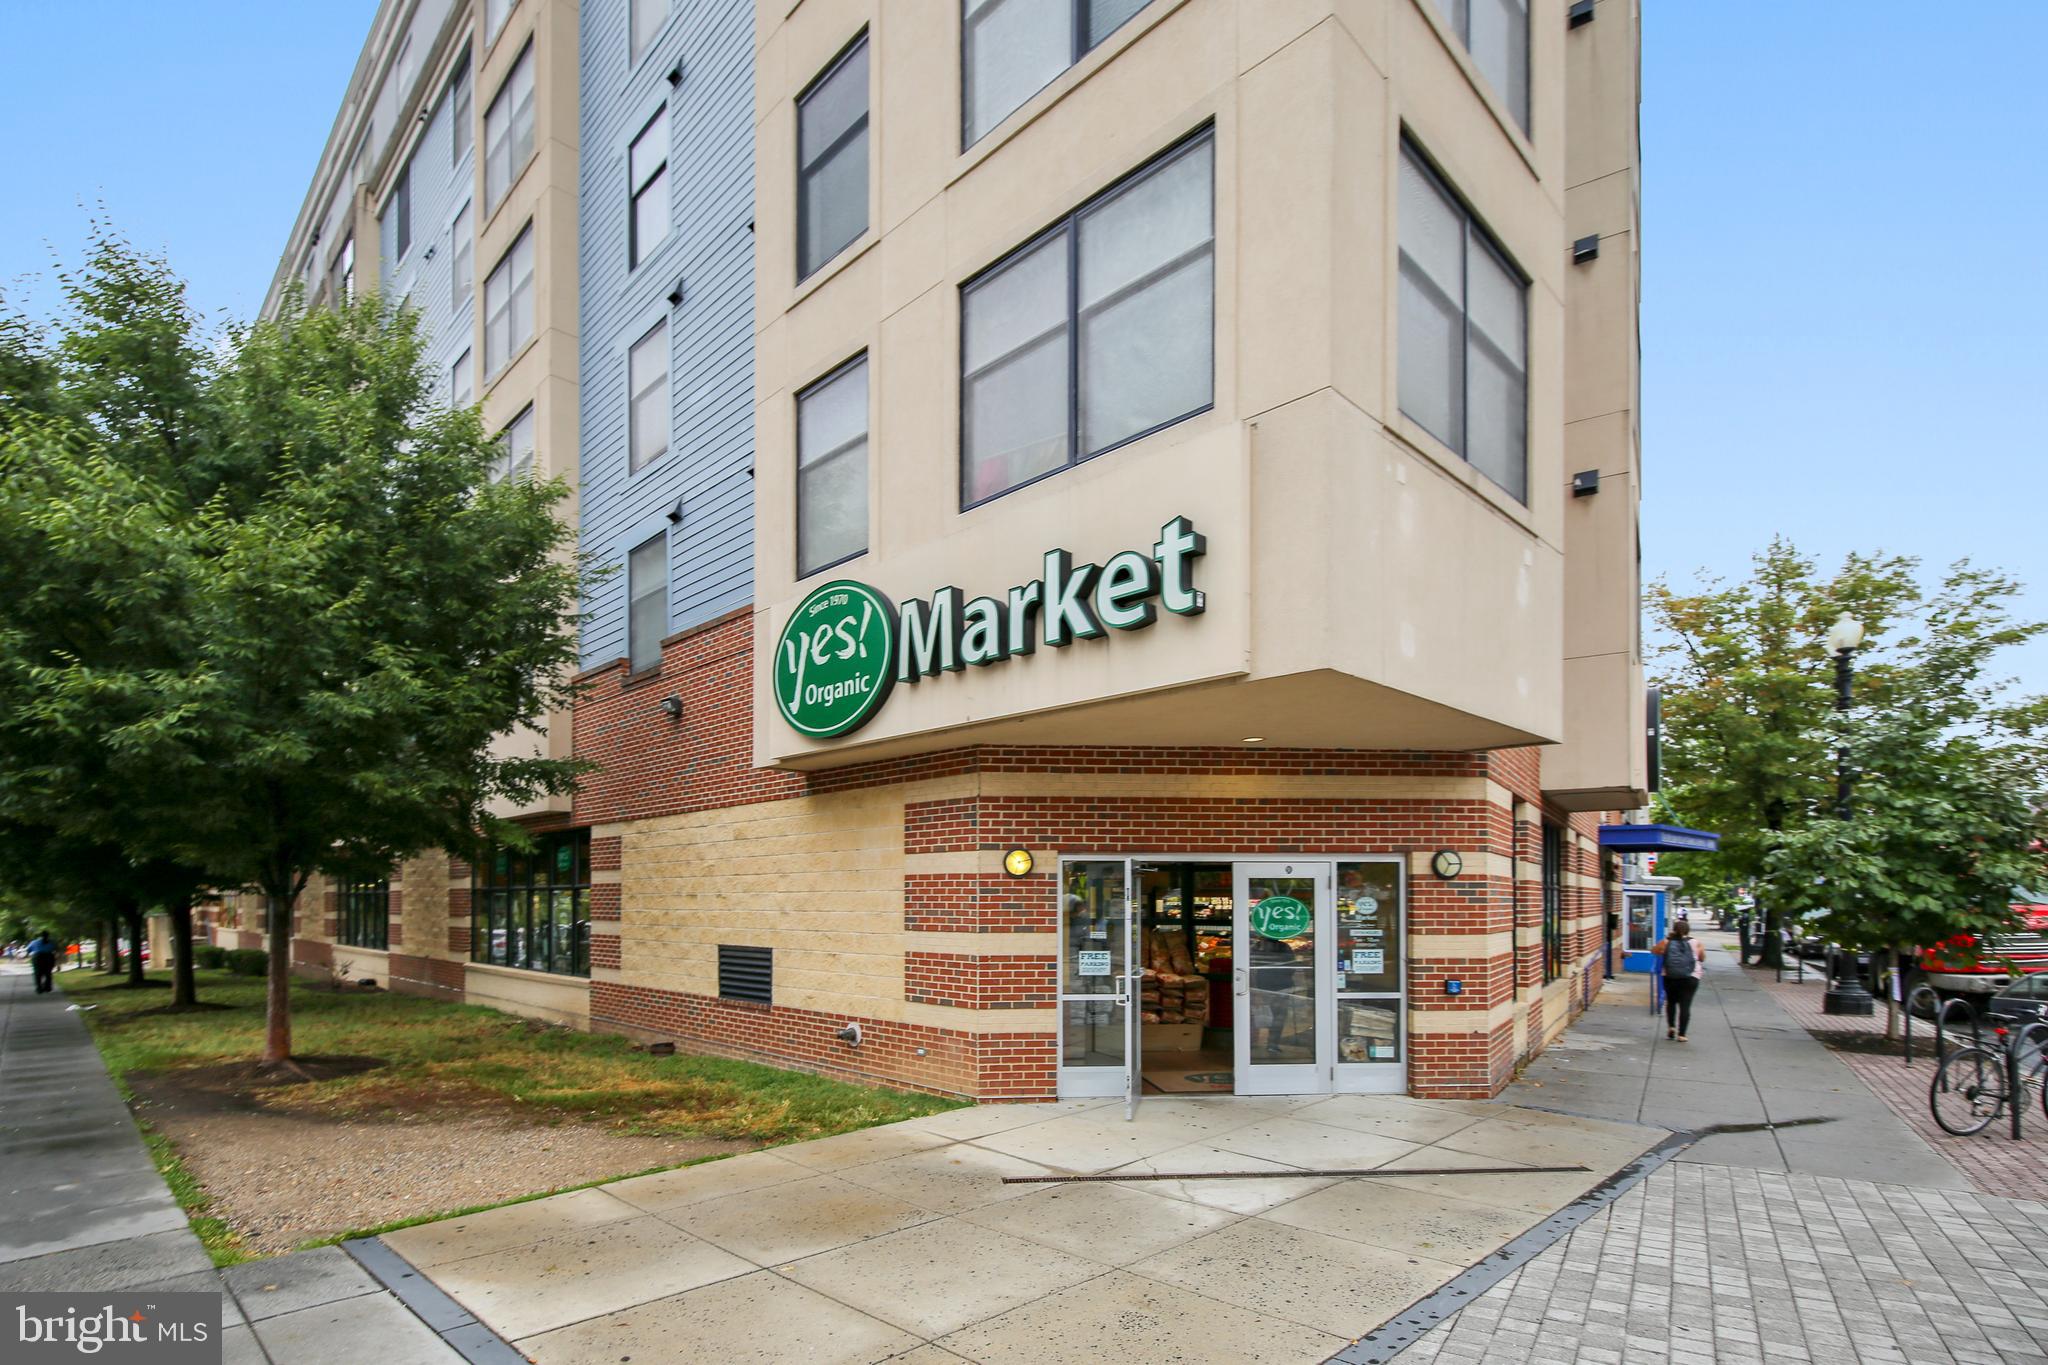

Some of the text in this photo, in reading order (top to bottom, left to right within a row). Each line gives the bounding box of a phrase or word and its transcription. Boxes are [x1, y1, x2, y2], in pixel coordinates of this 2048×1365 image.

[809, 594, 849, 617] Since 1970
[897, 515, 1206, 683] Market
[785, 600, 872, 714] yes!
[805, 672, 870, 707] Organic
[1257, 904, 1302, 932] yes!
[1269, 923, 1302, 932] Organic
[1353, 951, 1381, 959] FREE
